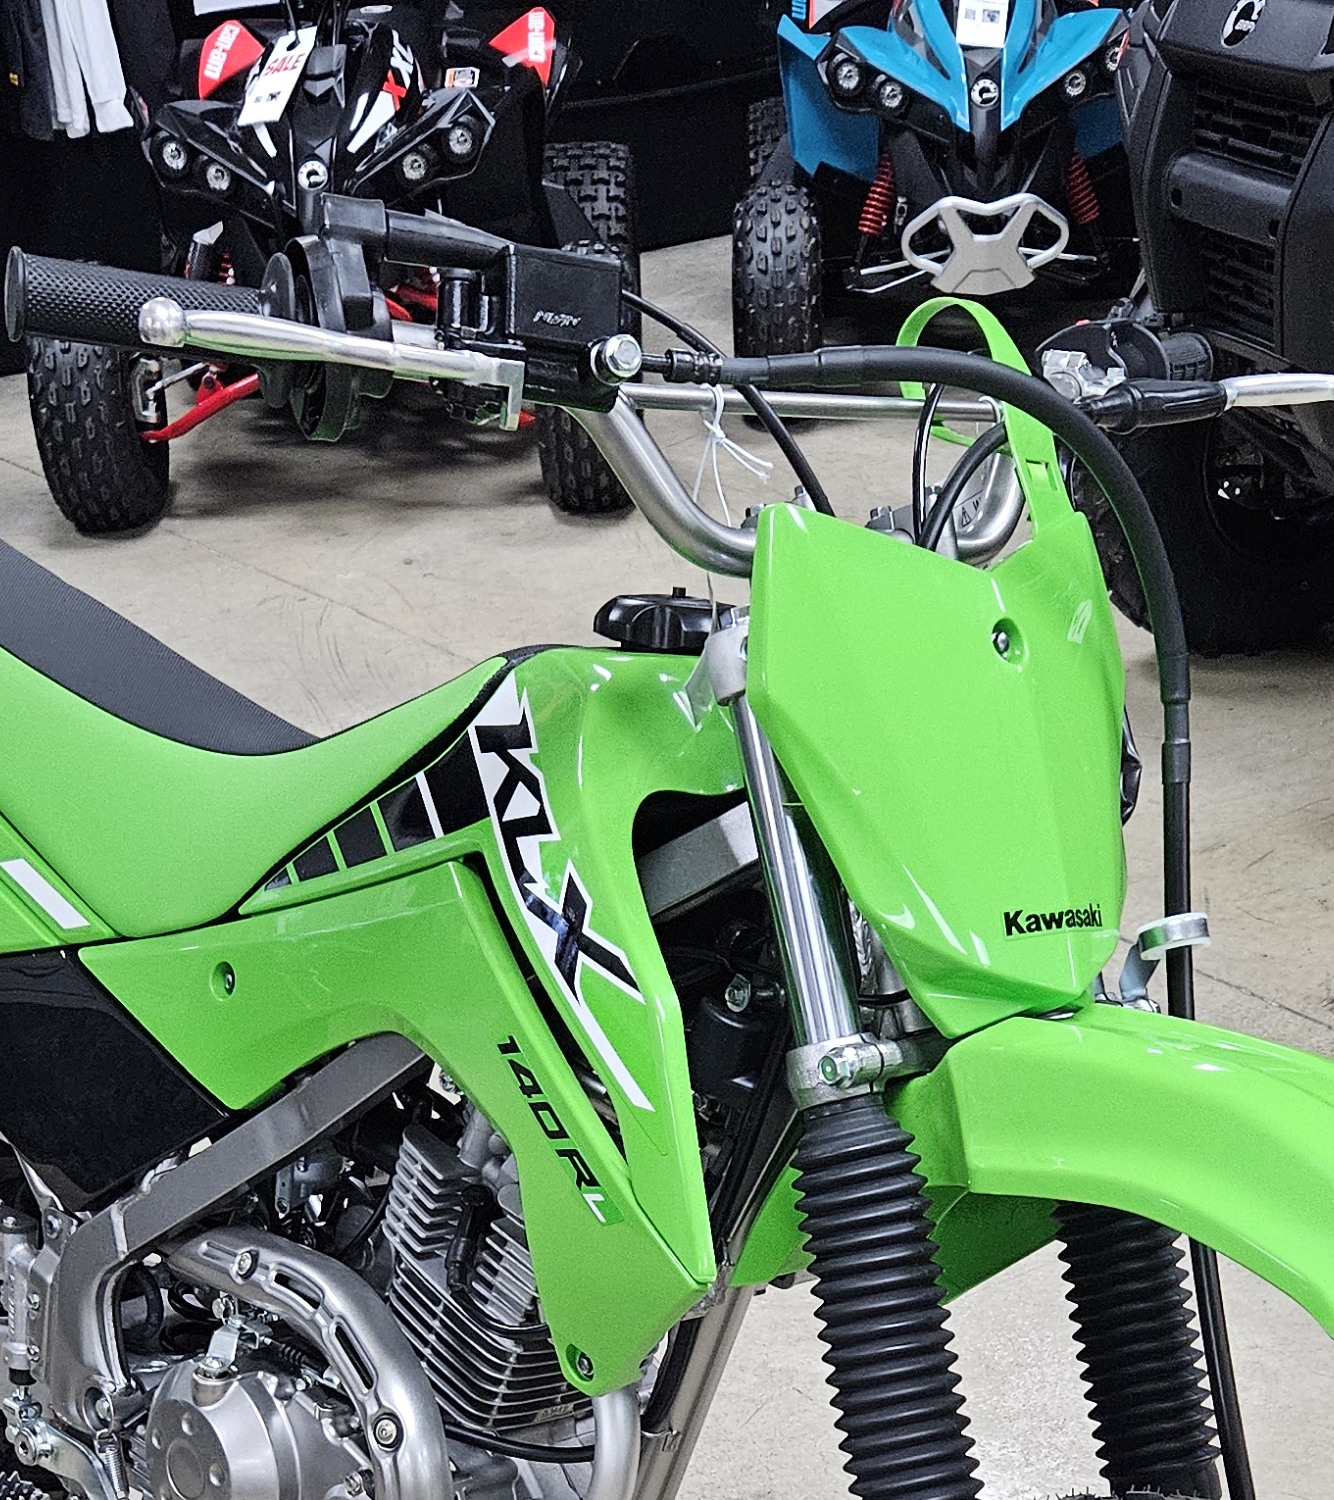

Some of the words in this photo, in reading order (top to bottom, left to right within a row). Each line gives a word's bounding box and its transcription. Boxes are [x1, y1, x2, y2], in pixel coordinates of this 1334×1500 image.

[264, 52, 306, 77] SALE
[473, 704, 644, 1007] KLX
[1003, 902, 1103, 937] Kawasaki
